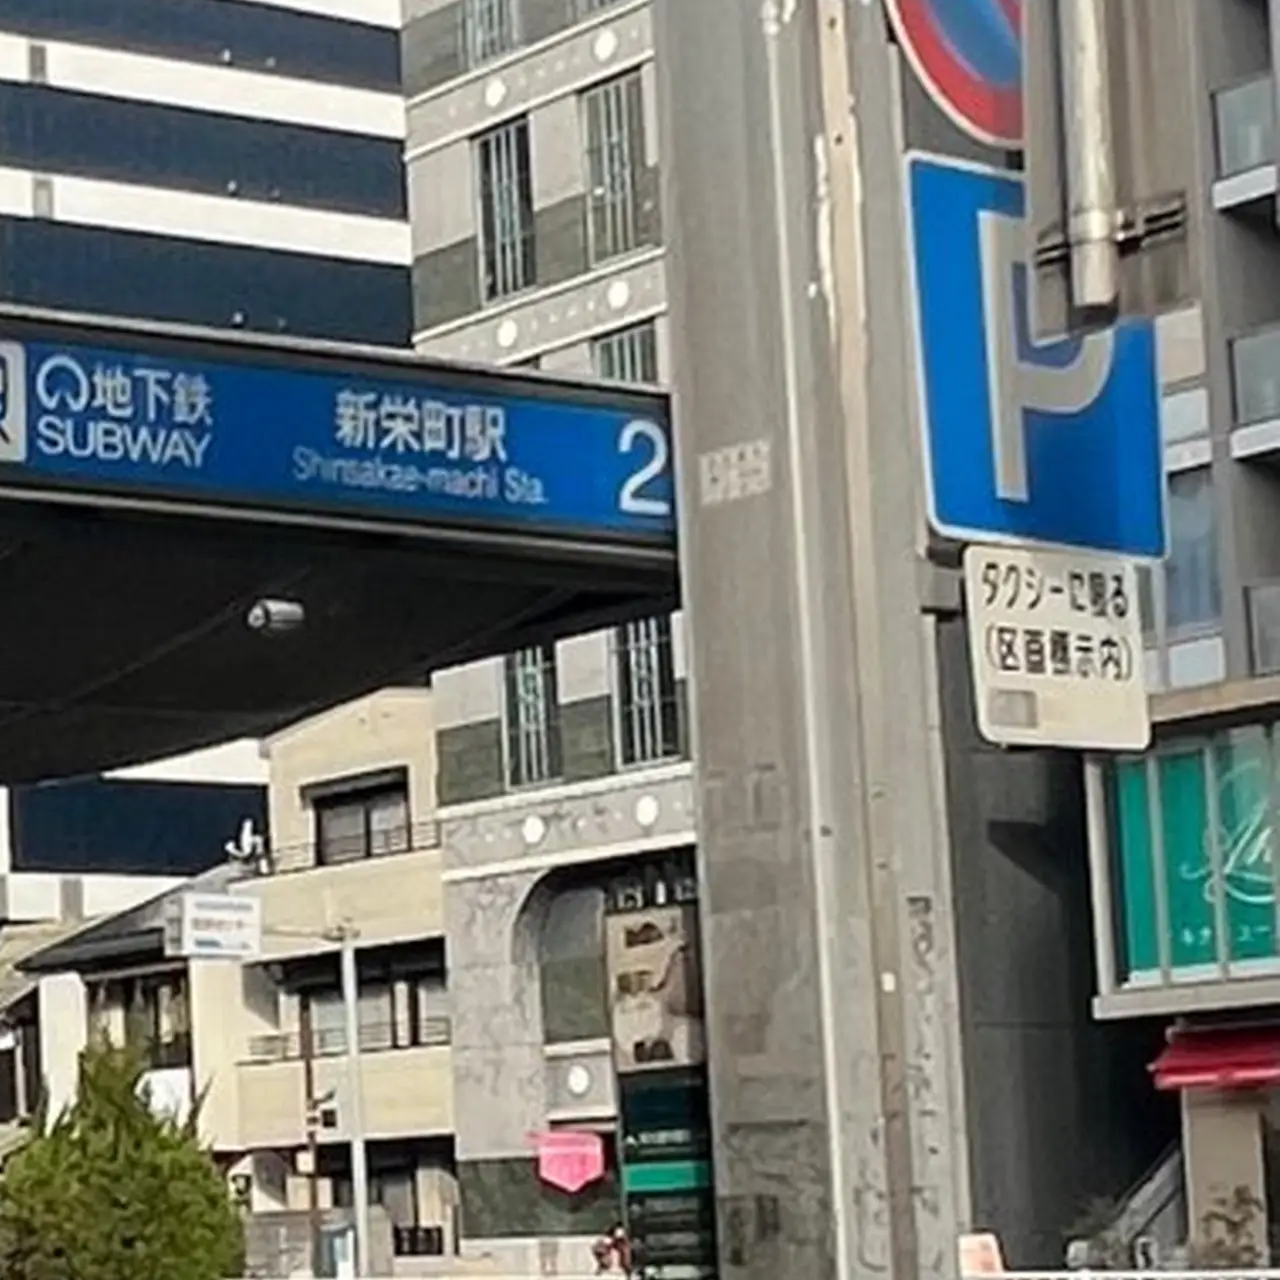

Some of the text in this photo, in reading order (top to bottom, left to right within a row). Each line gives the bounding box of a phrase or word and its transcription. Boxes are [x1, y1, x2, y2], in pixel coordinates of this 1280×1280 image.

[977, 210, 1116, 501] P
[92, 363, 213, 426] 地下鉄
[335, 390, 507, 462] 新栄町駅
[37, 415, 212, 468] SUBWAY
[618, 420, 670, 516] 2
